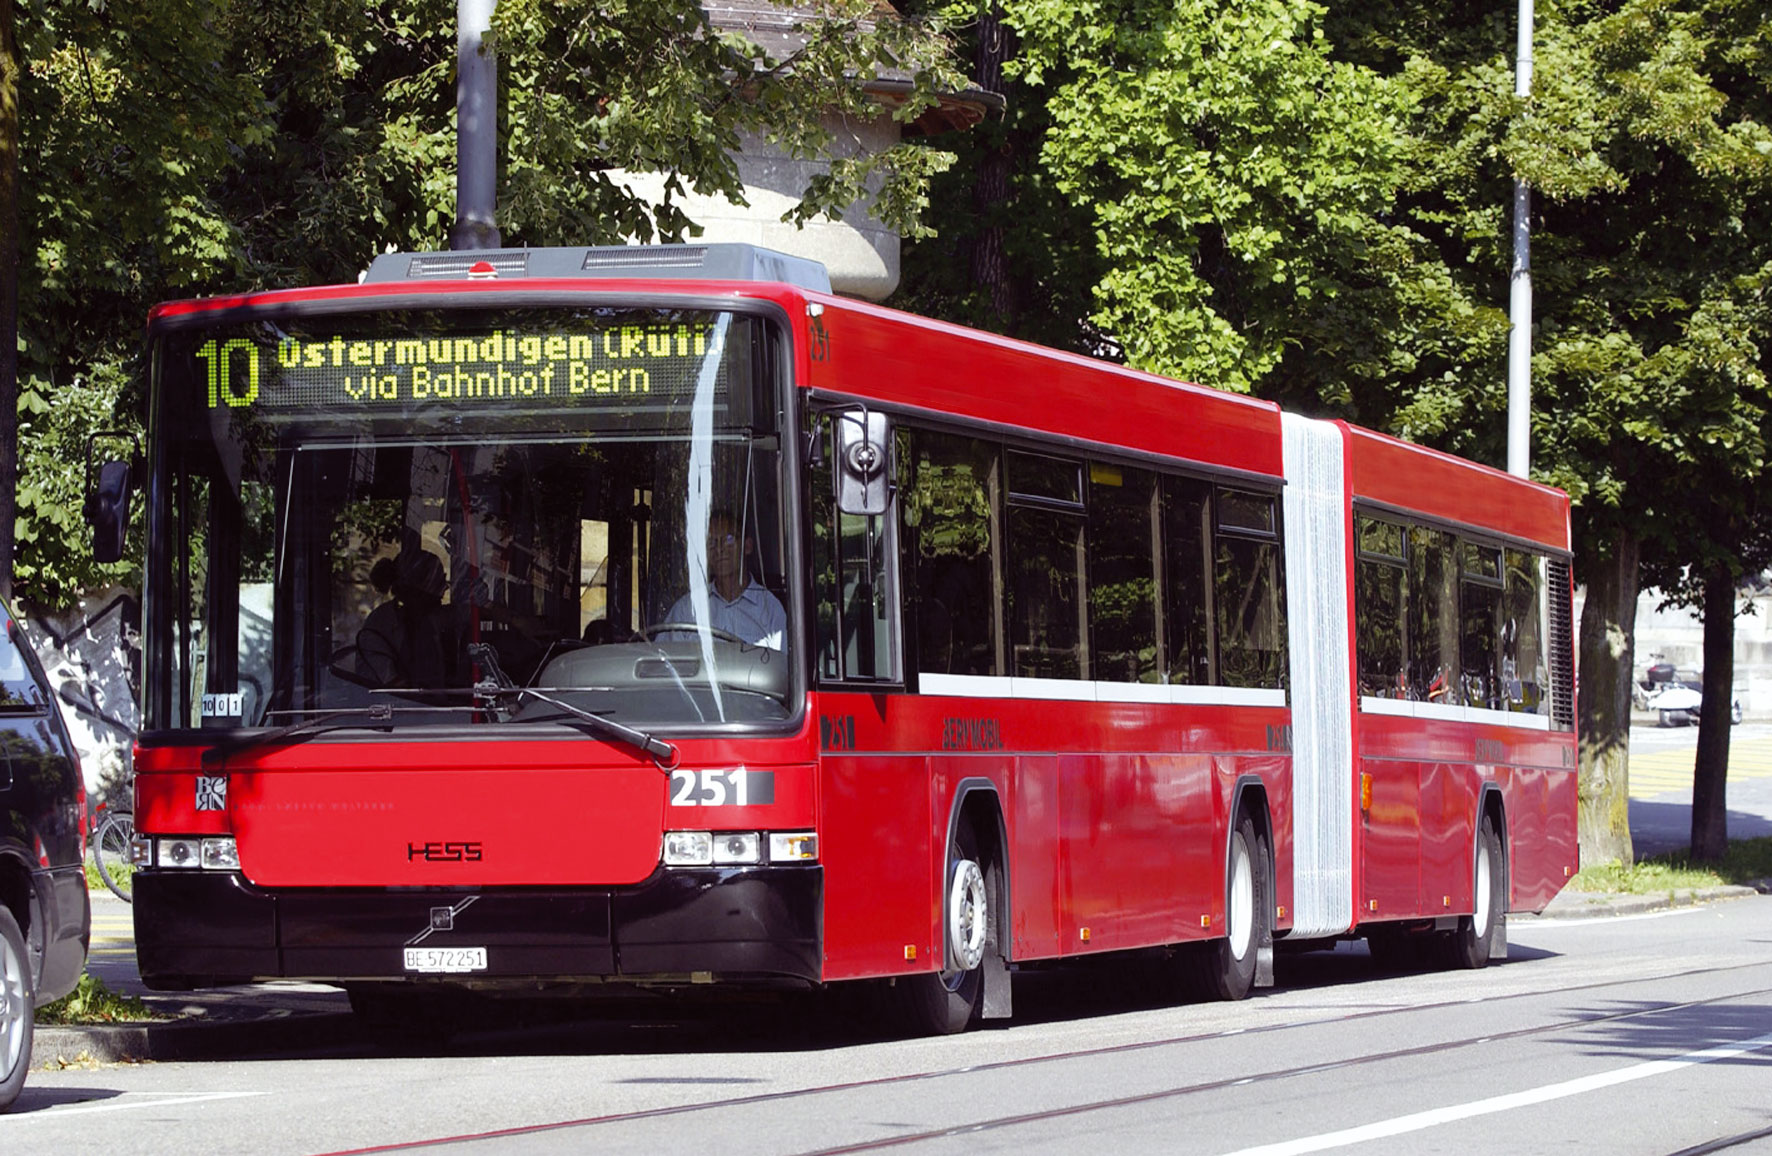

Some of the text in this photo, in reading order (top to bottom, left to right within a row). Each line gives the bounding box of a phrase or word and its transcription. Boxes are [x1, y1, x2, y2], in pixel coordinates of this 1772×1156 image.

[278, 329, 593, 368] Ostermundigen
[196, 338, 259, 408] 10
[345, 360, 650, 400] via Bahnhof Bern
[671, 768, 748, 807] 251
[407, 842, 483, 862] HESS
